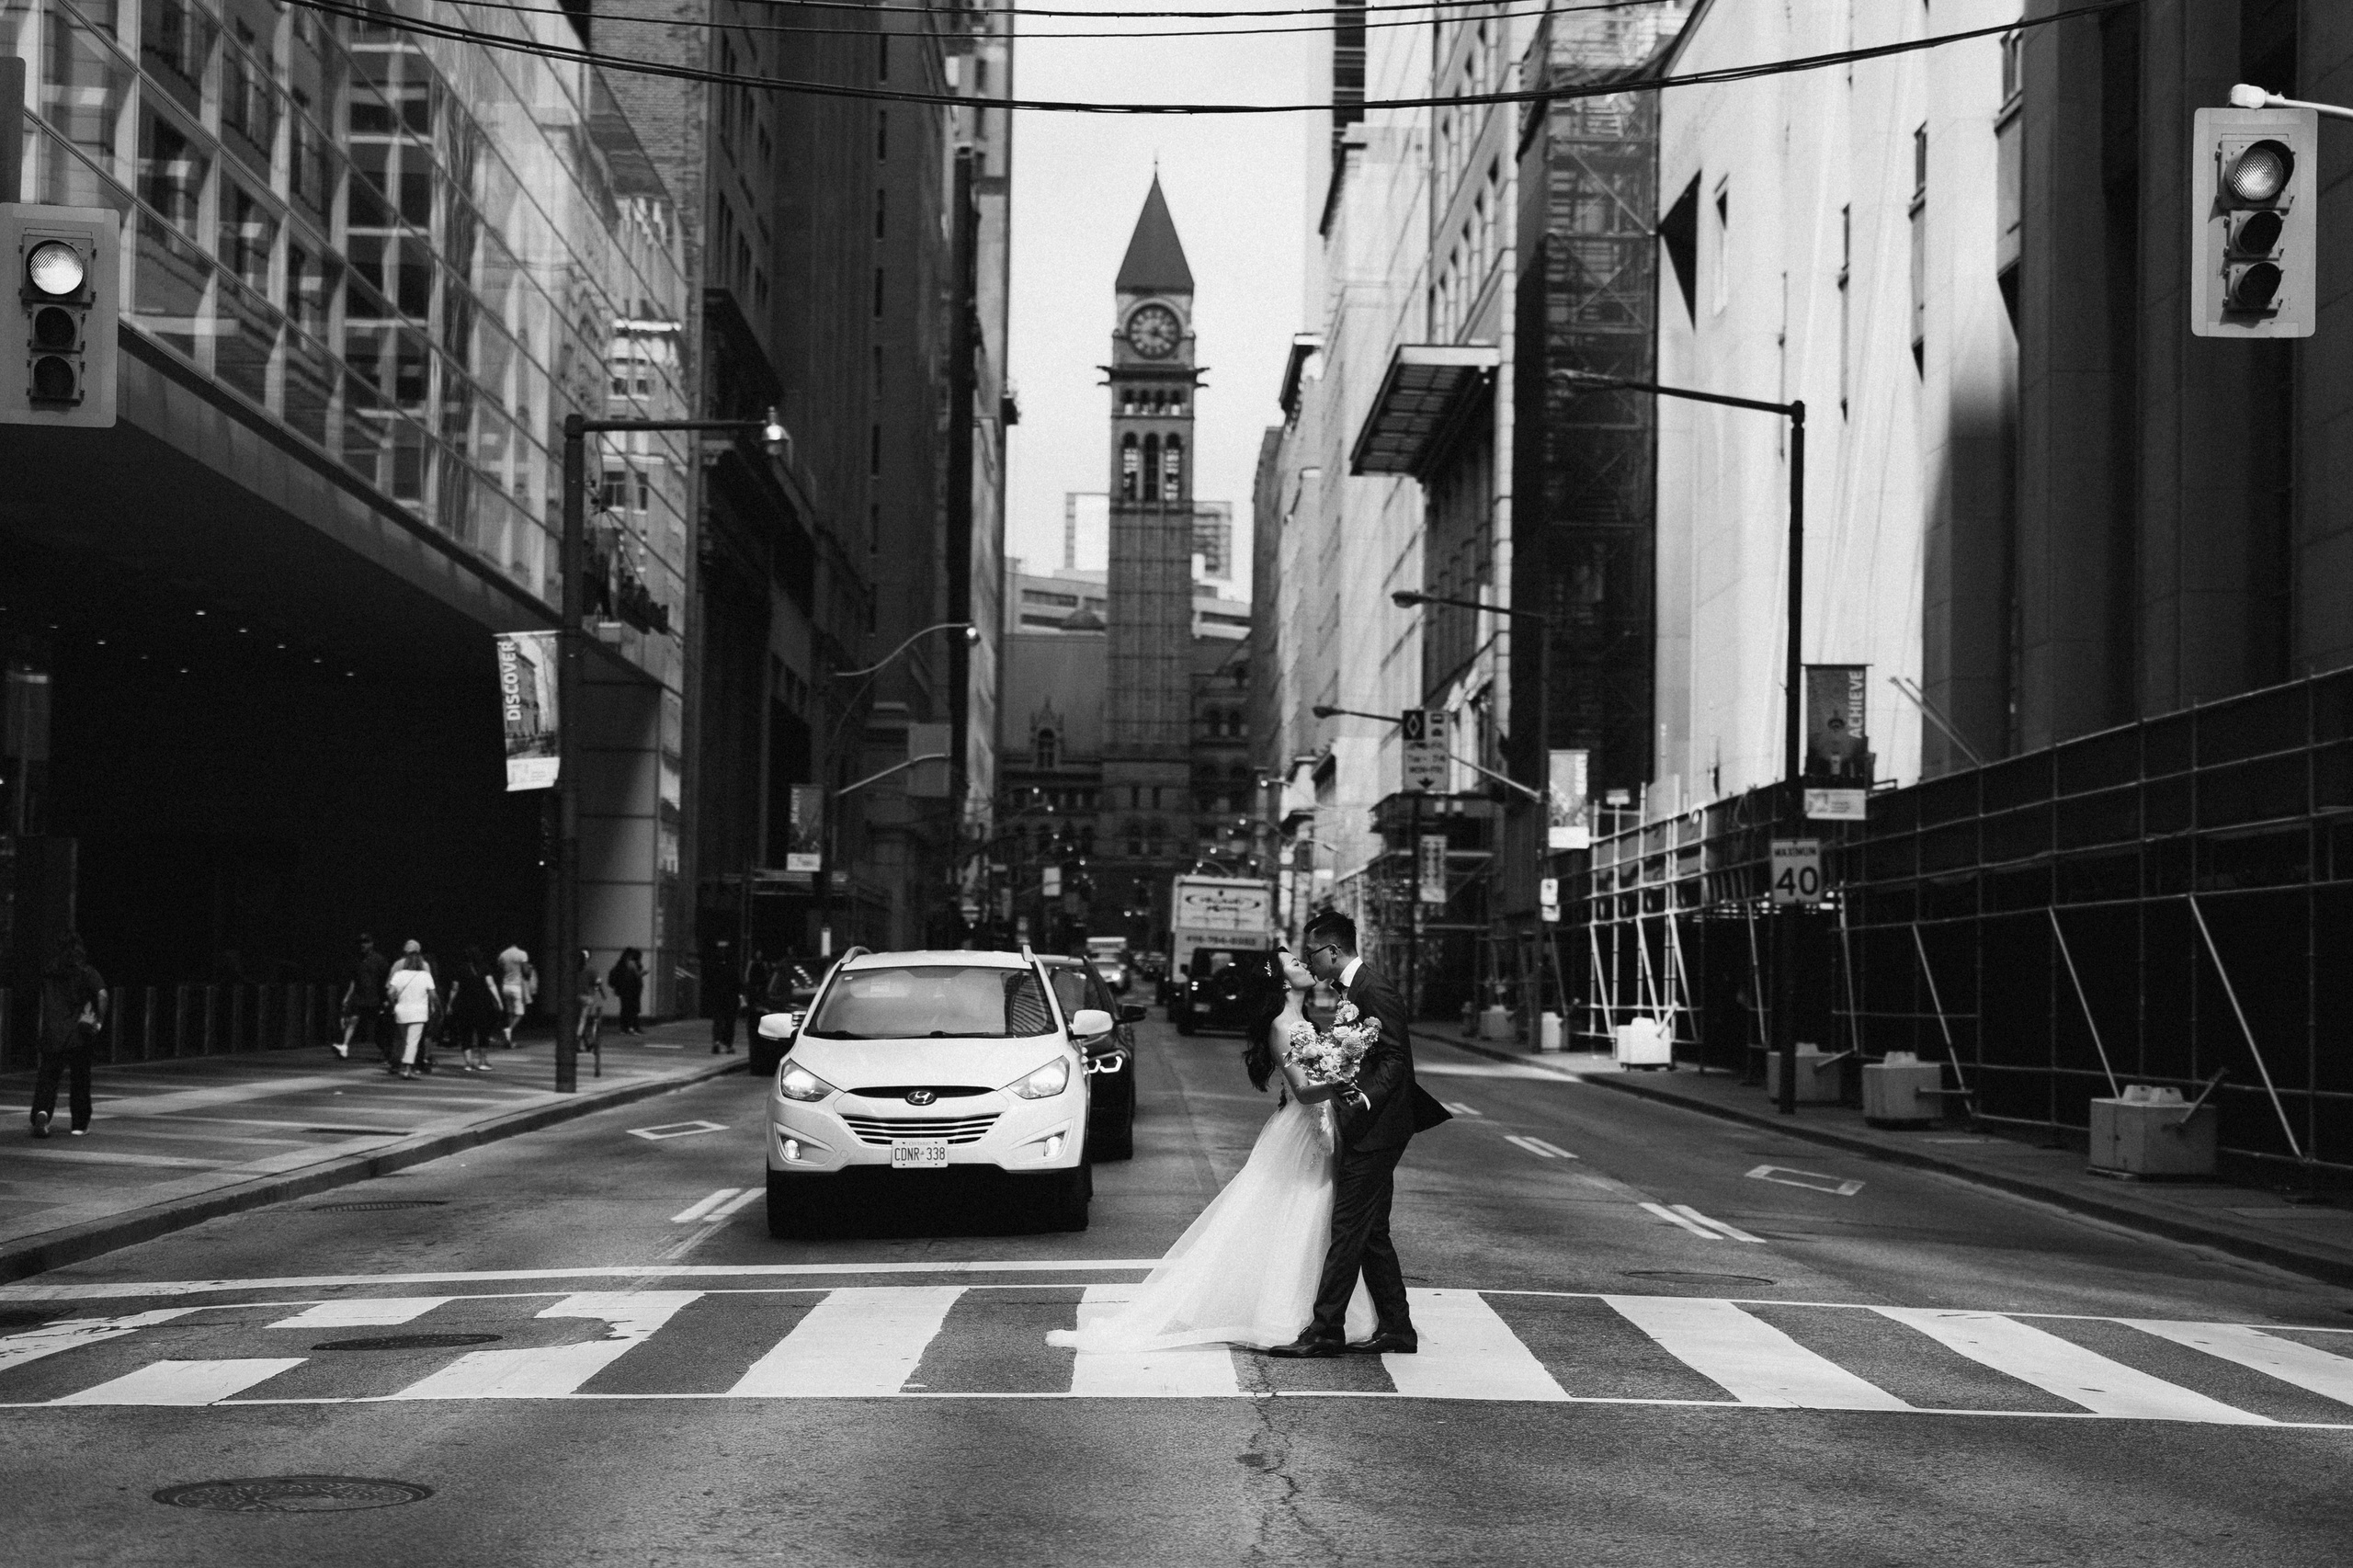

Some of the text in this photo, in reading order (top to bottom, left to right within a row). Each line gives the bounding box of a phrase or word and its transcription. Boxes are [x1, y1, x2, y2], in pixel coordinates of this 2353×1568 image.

[501, 642, 521, 721] DISCOVER
[1847, 671, 1864, 738] ACHIEVE
[1774, 846, 1817, 857] MAXIMUM
[1775, 867, 1818, 896] 40
